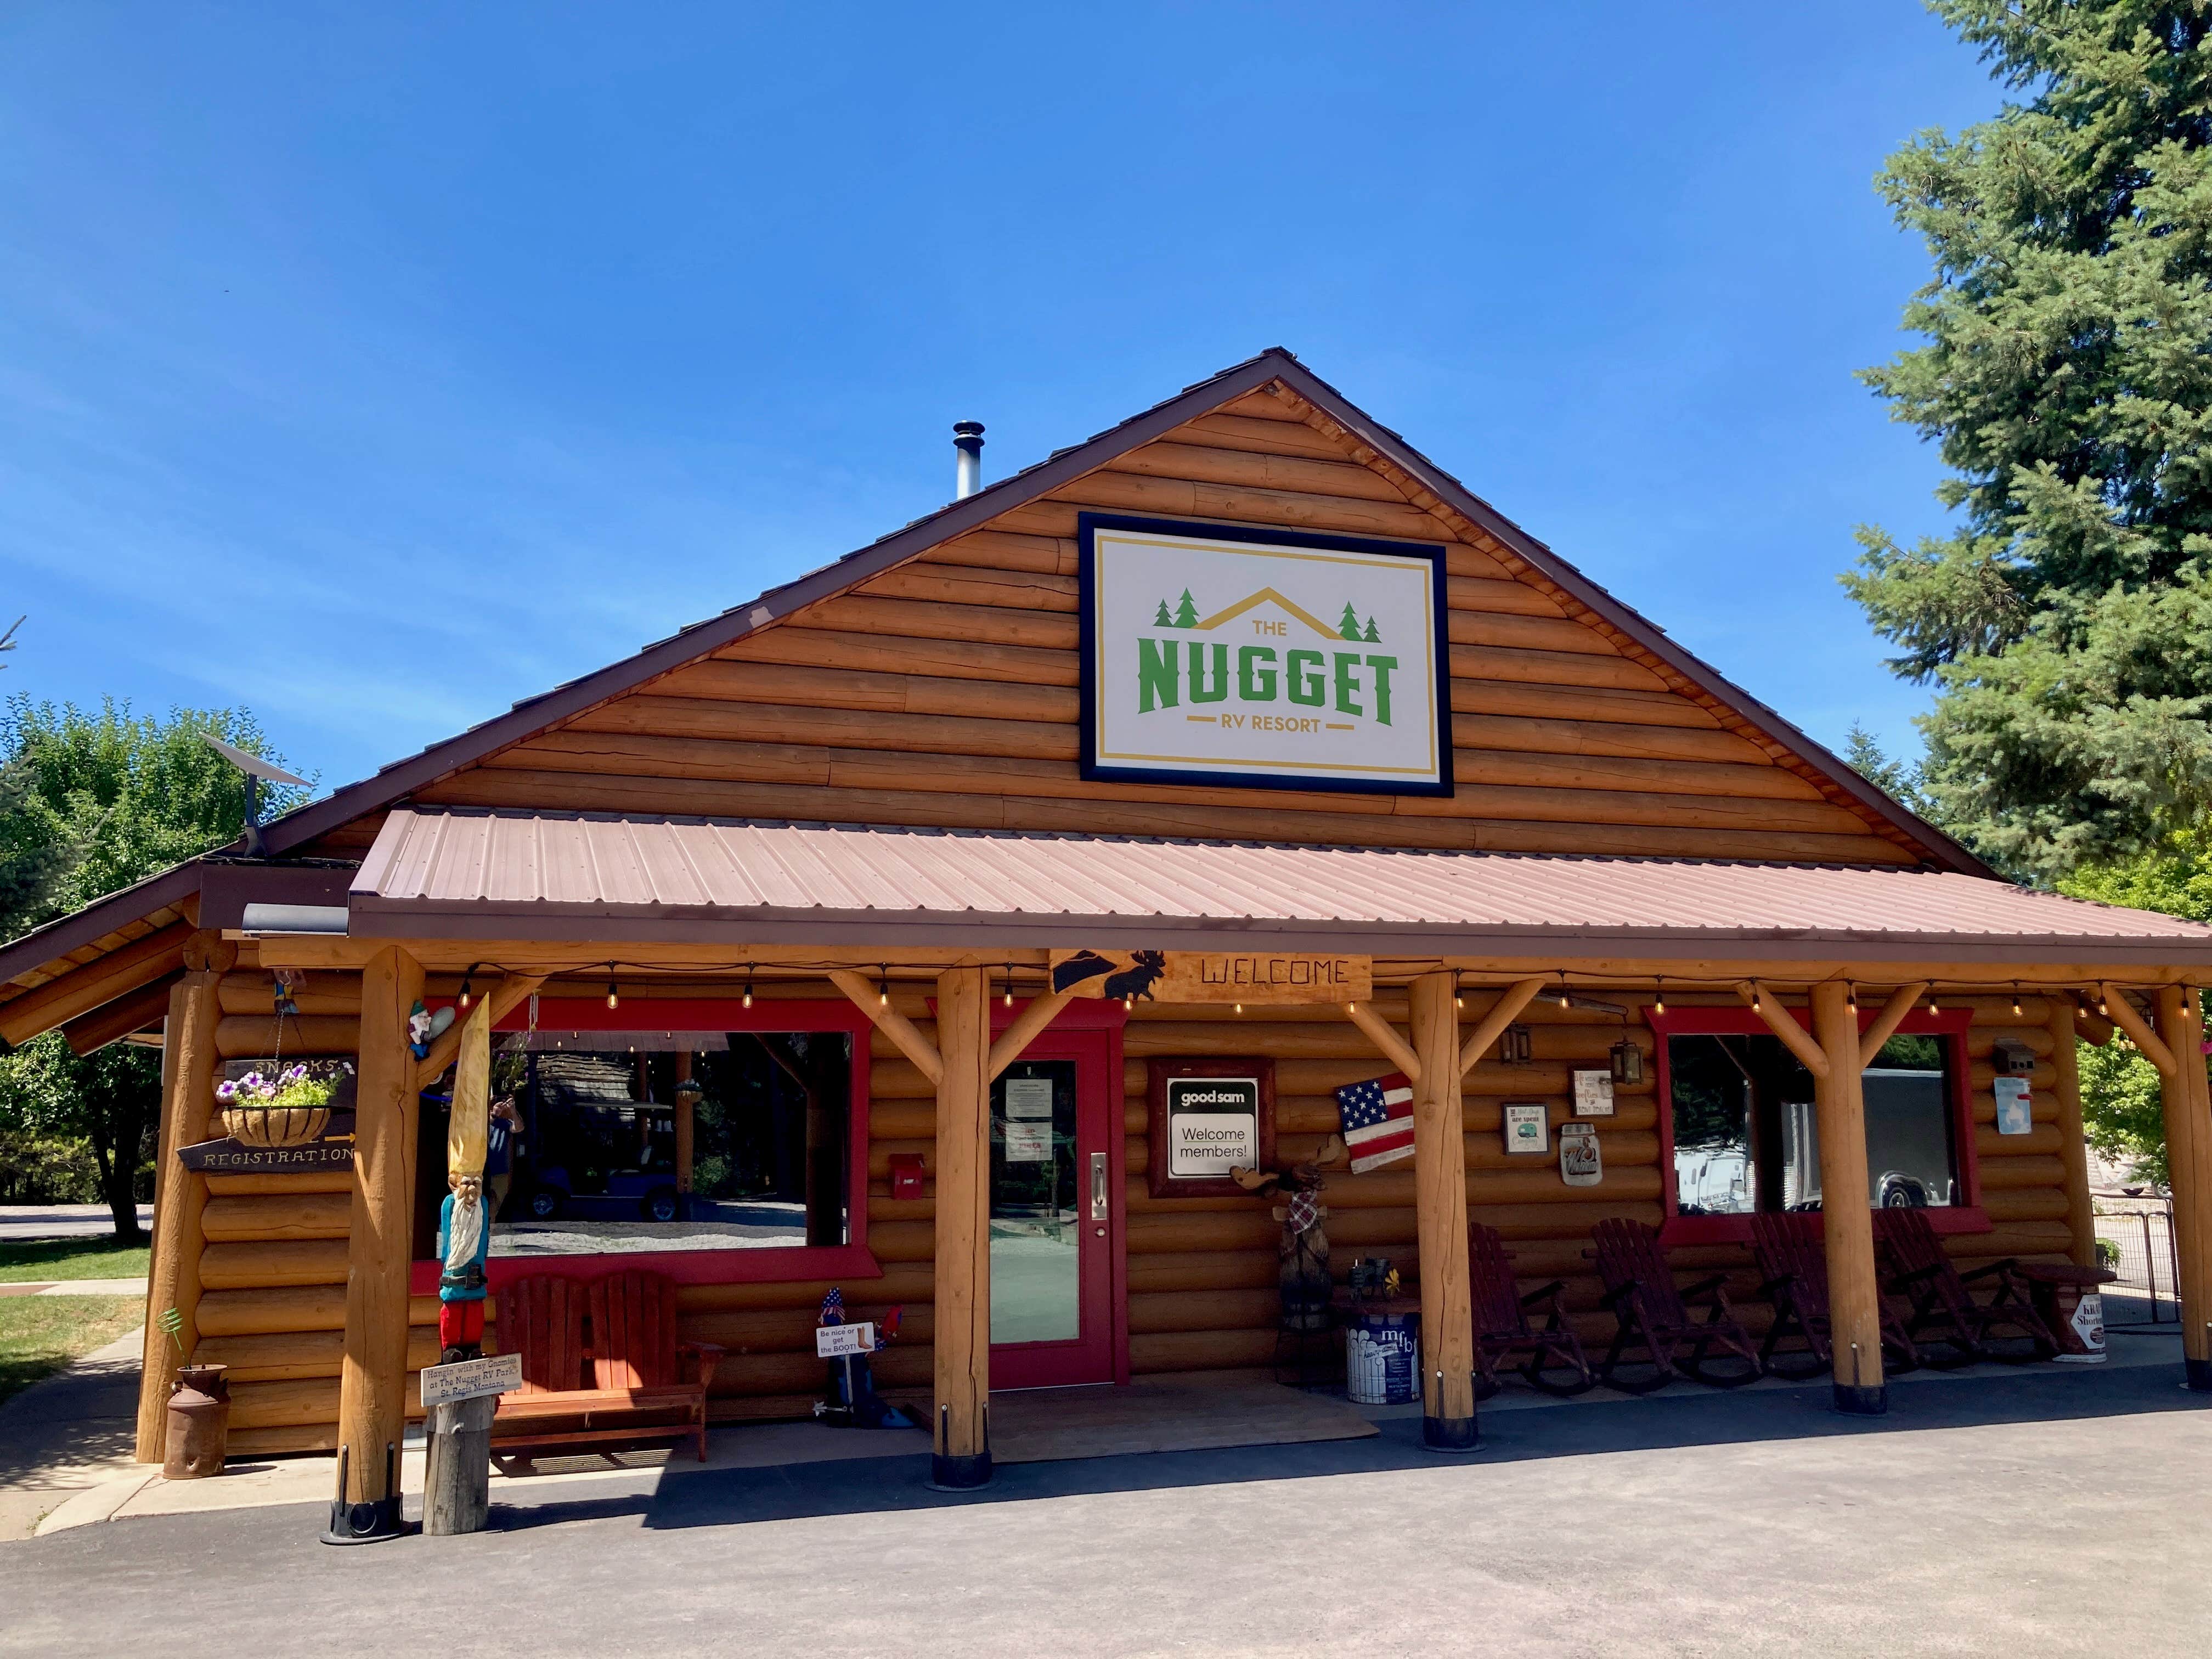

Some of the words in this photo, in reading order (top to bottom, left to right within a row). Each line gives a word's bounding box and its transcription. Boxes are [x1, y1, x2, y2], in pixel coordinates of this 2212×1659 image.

[1252, 620, 1287, 636] THE
[1137, 637, 1398, 727] NUGGET
[1221, 713, 1246, 729] RV
[1252, 715, 1321, 733] RESORT
[1201, 958, 1349, 985] WELCOME
[1181, 1128, 1245, 1140] Welcome
[202, 1149, 355, 1166] REGISTRATION
[1180, 1144, 1246, 1158] members!
[833, 1344, 856, 1352] BOOT!
[458, 1363, 473, 1373] with
[488, 1357, 517, 1368] Gnomies
[440, 1378, 453, 1387] The
[456, 1374, 481, 1385] Nugget
[483, 1370, 494, 1379] RV
[453, 1385, 472, 1397] Regis
[474, 1380, 505, 1392] Montana
